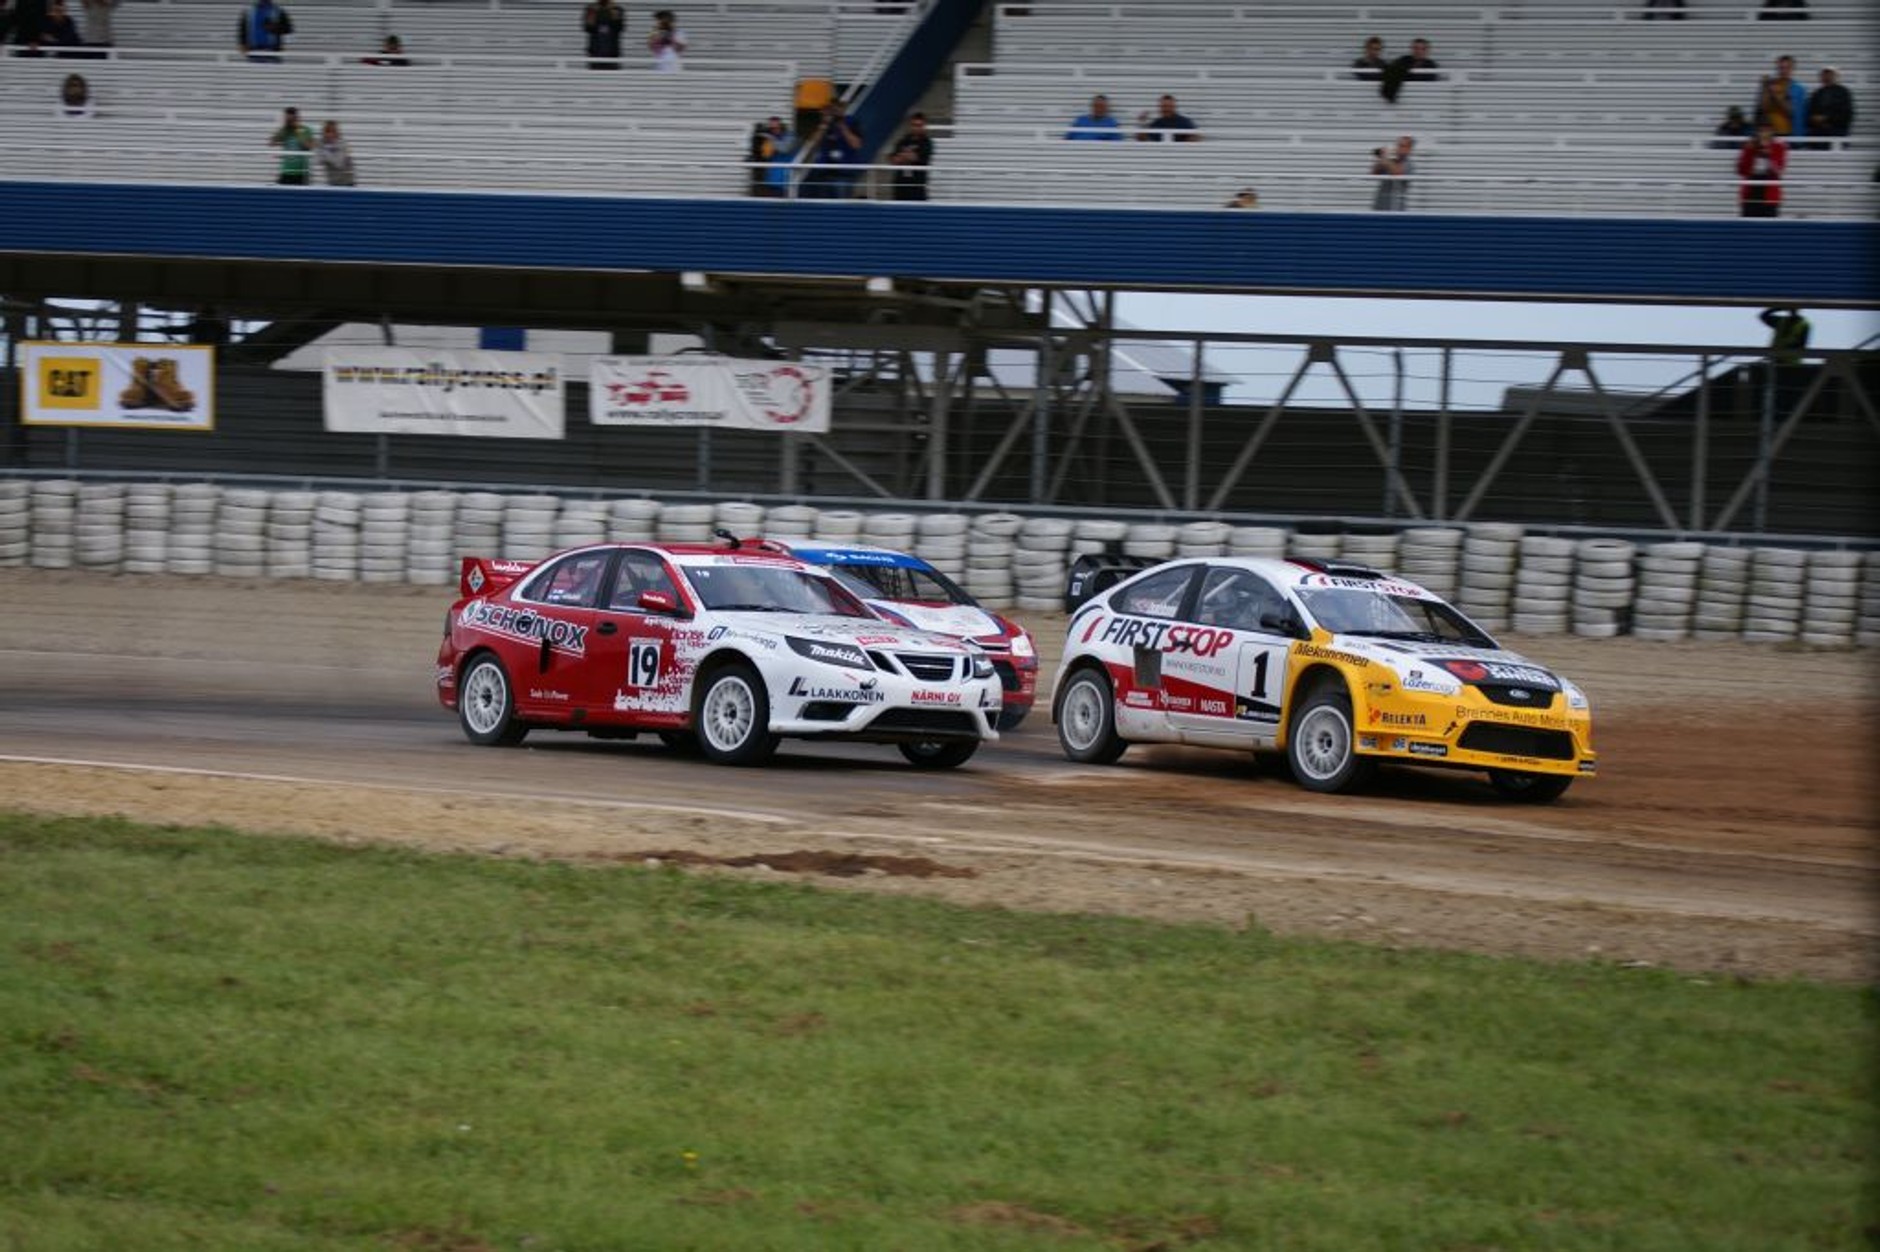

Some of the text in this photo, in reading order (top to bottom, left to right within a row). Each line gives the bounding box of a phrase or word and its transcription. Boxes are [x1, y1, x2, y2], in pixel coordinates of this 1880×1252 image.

[49, 369, 92, 397] CAT
[335, 362, 557, 395] www.rallycross.pl
[631, 645, 659, 686] 19
[1294, 643, 1370, 668] Mekonomen
[1251, 650, 1270, 699] 1
[811, 687, 885, 701] LAAKKONEN
[1456, 705, 1510, 721] Brennes
